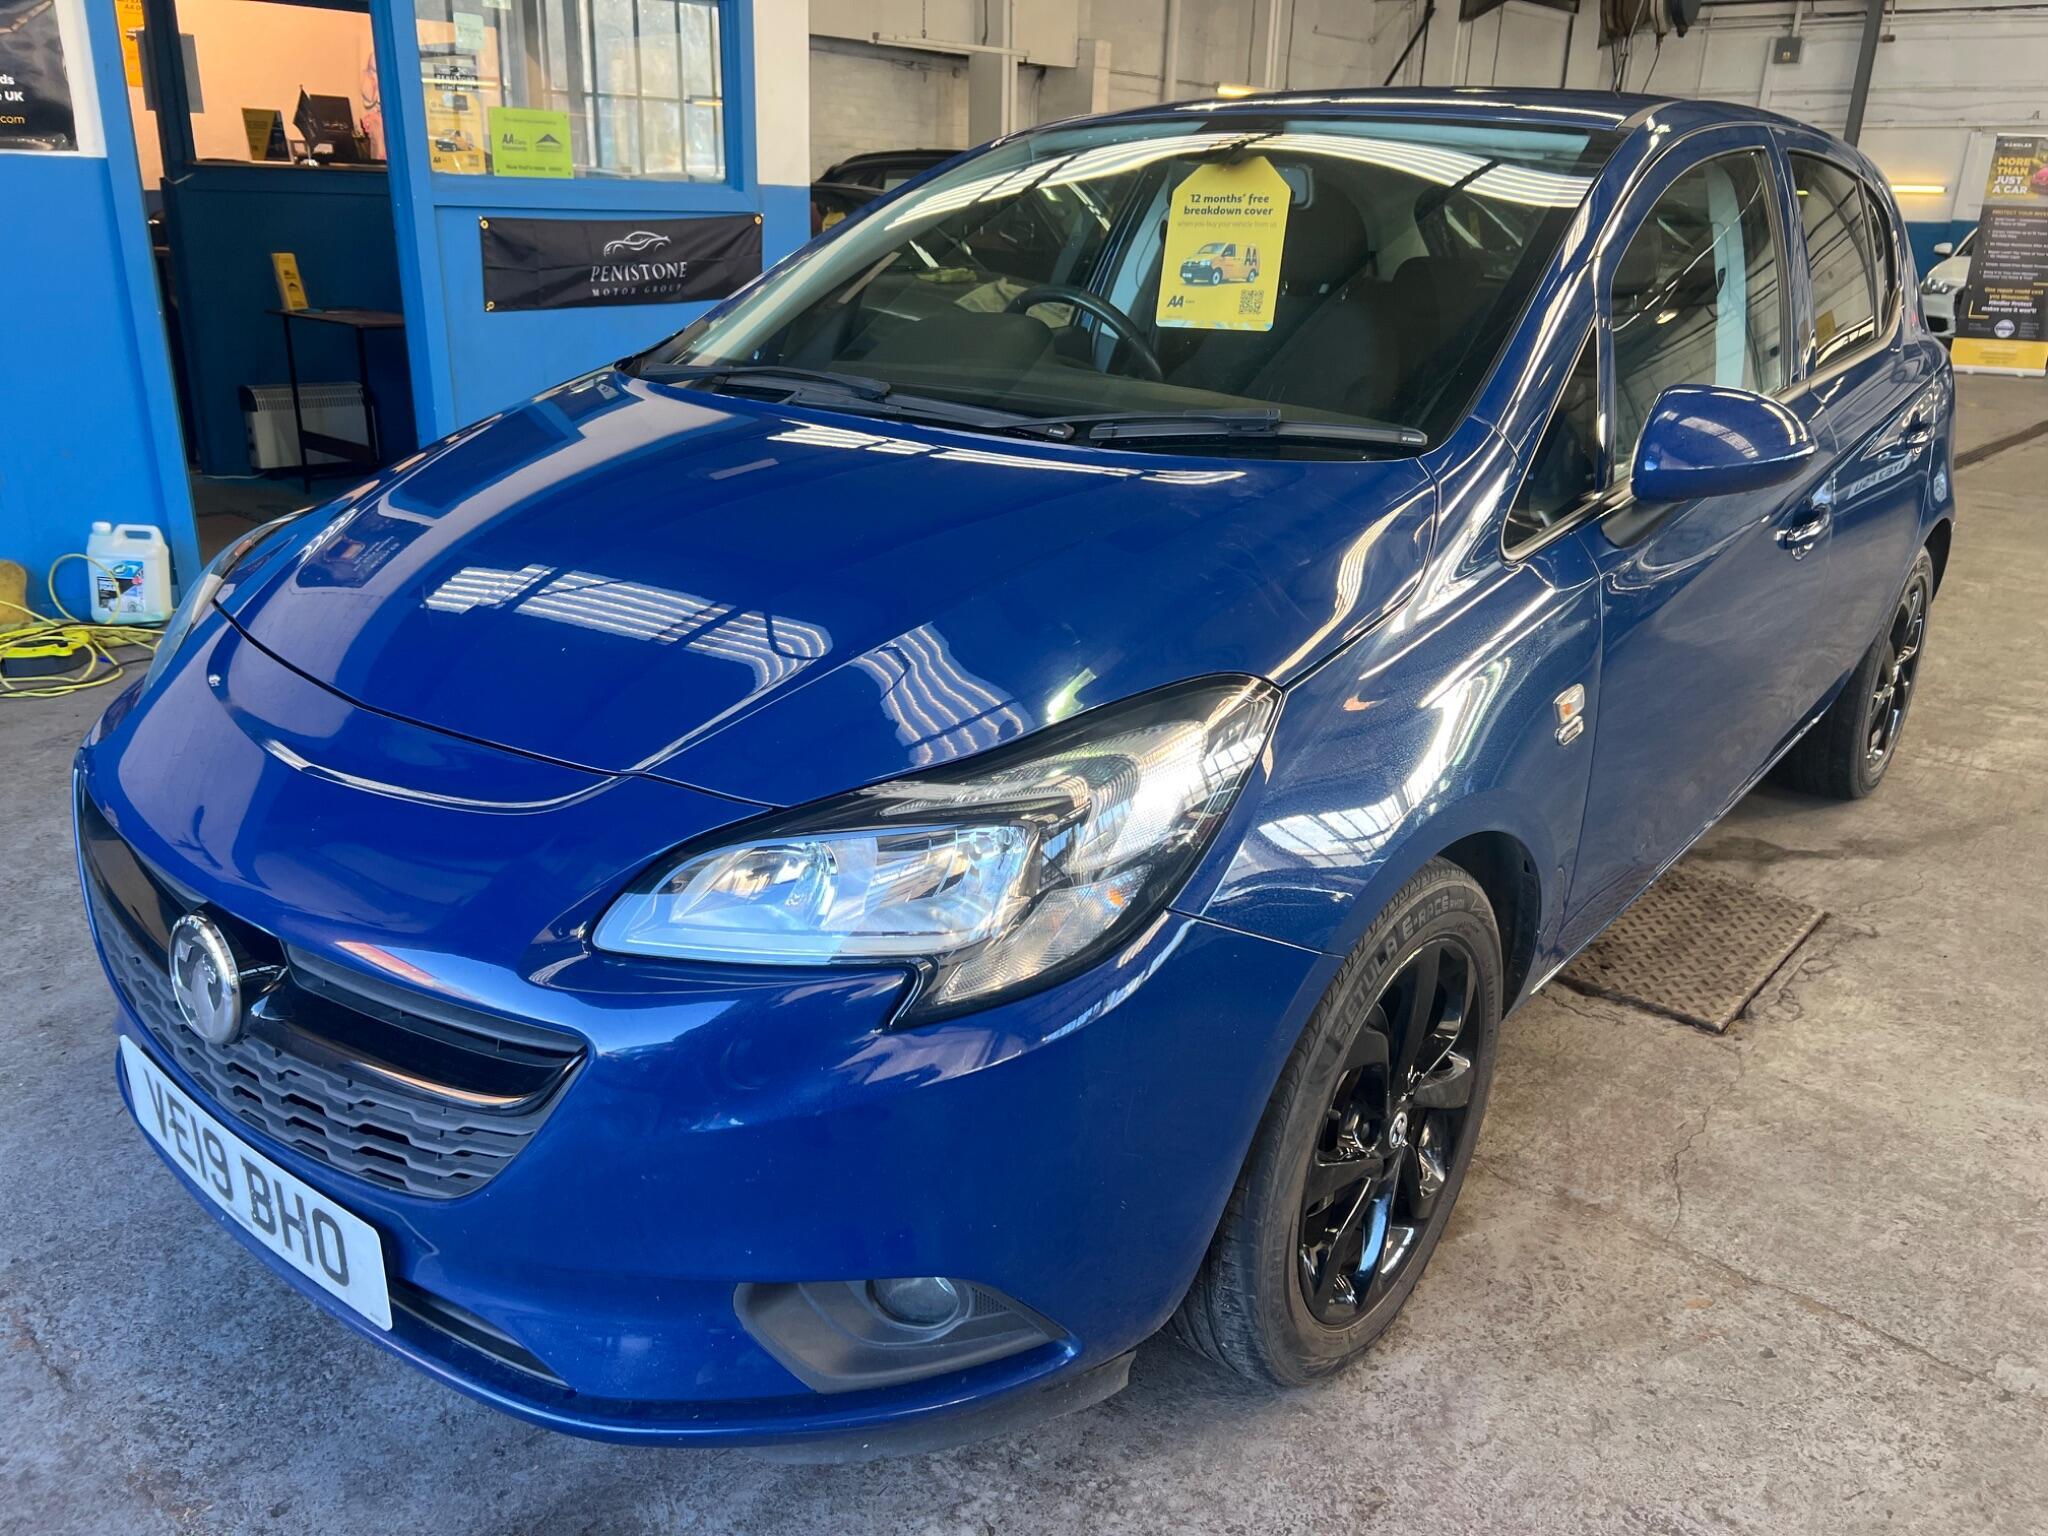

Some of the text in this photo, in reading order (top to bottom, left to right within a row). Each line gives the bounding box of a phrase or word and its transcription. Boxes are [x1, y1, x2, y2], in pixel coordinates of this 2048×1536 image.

[5, 91, 24, 102] UK
[1998, 157, 2031, 166] MORE
[1997, 166, 2029, 176] THAN
[1994, 176, 2024, 184] JUST
[1992, 185, 2028, 194] A CAR
[1191, 194, 1201, 203] 12
[1248, 194, 1270, 206] free
[1184, 205, 1274, 216] breakdown cover
[1244, 247, 1258, 266] AA
[590, 262, 688, 283] PENISTONE
[591, 284, 682, 297] MOTOR GROUP
[1167, 295, 1185, 308] AA
[1402, 895, 1449, 941] E-RACE
[143, 1068, 350, 1287] VE19 BHO
